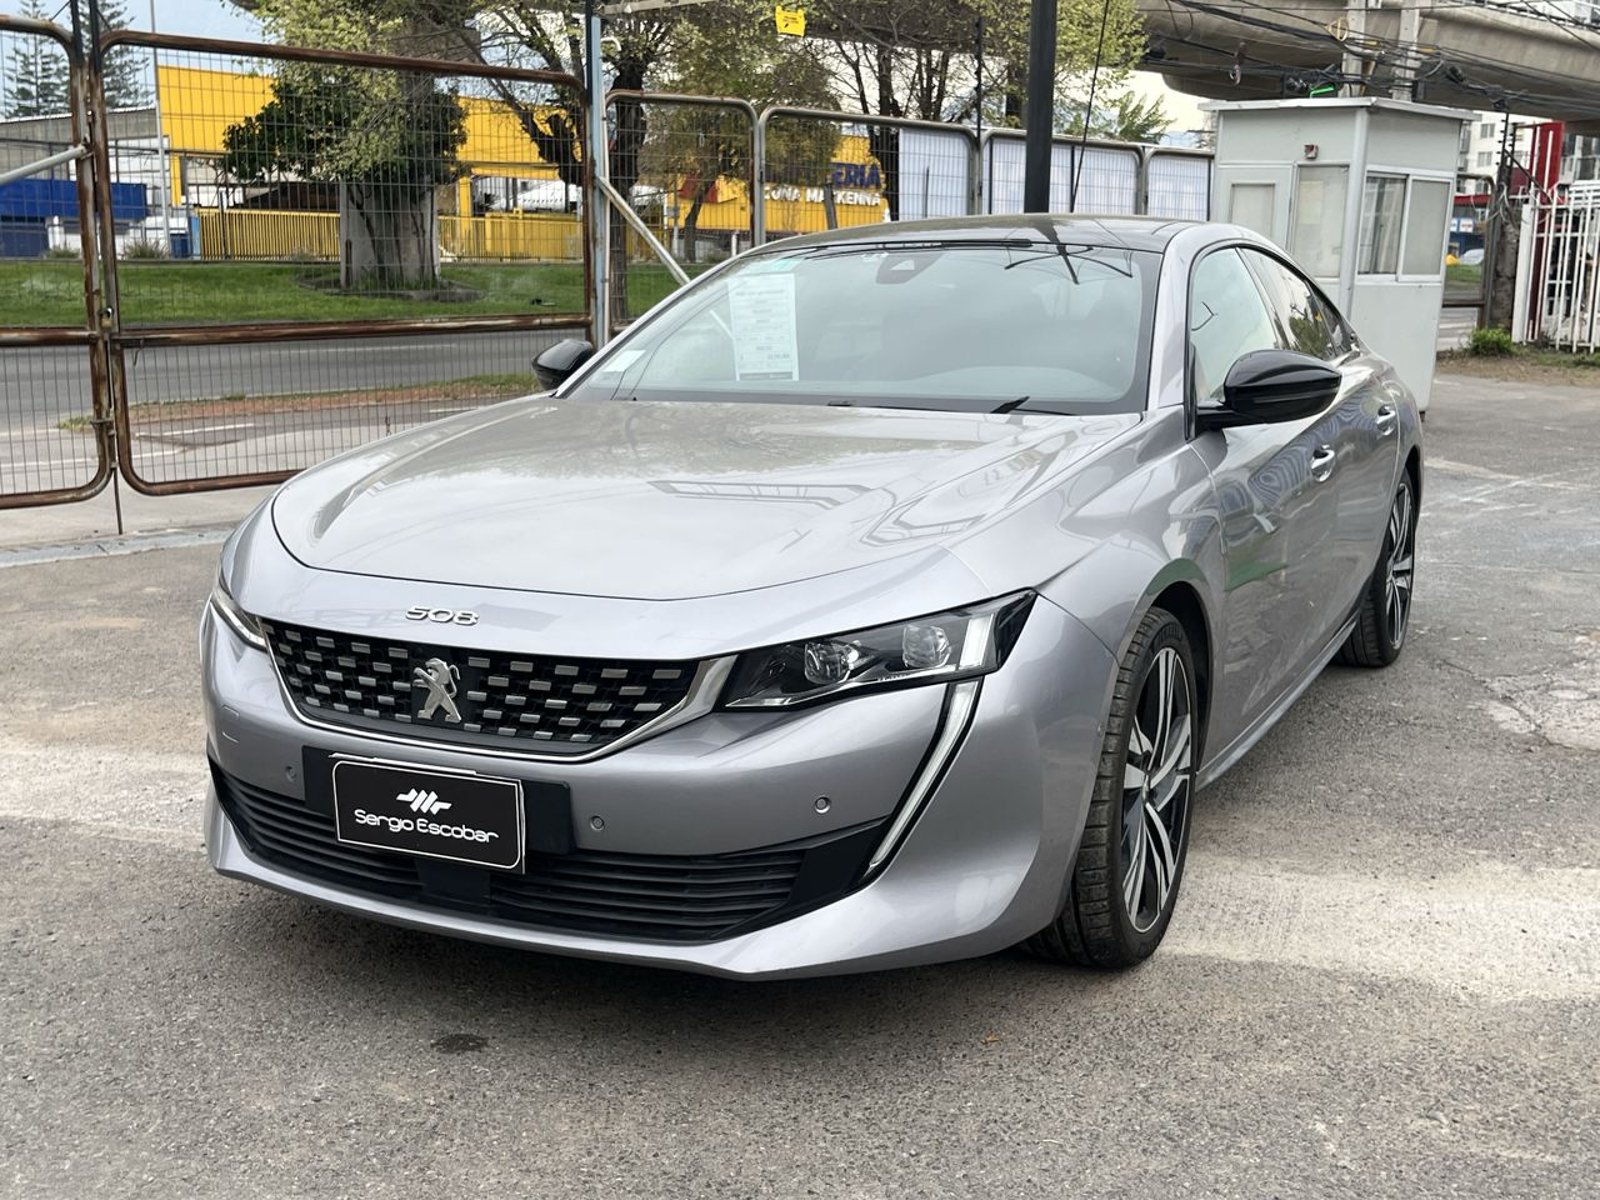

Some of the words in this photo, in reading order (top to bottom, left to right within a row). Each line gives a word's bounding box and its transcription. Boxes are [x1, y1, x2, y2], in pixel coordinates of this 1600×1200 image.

[405, 605, 479, 626] 508
[354, 808, 415, 833] Sergio
[416, 817, 500, 843] Escobar
